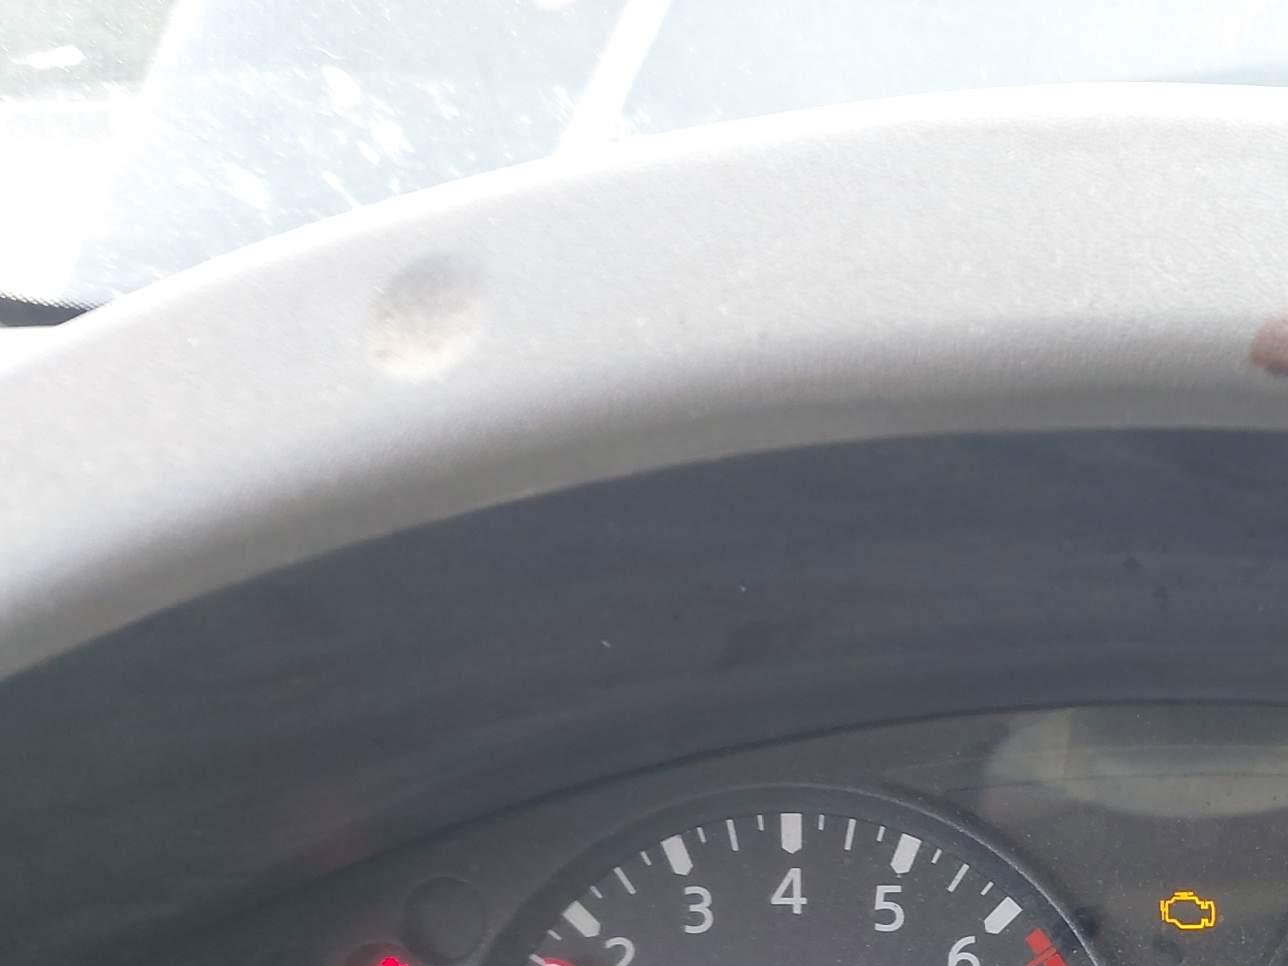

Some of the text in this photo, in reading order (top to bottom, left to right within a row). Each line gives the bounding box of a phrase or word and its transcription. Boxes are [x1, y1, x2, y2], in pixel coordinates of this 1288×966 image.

[683, 886, 714, 934] 3
[771, 868, 807, 915] 4
[874, 885, 905, 932] 5
